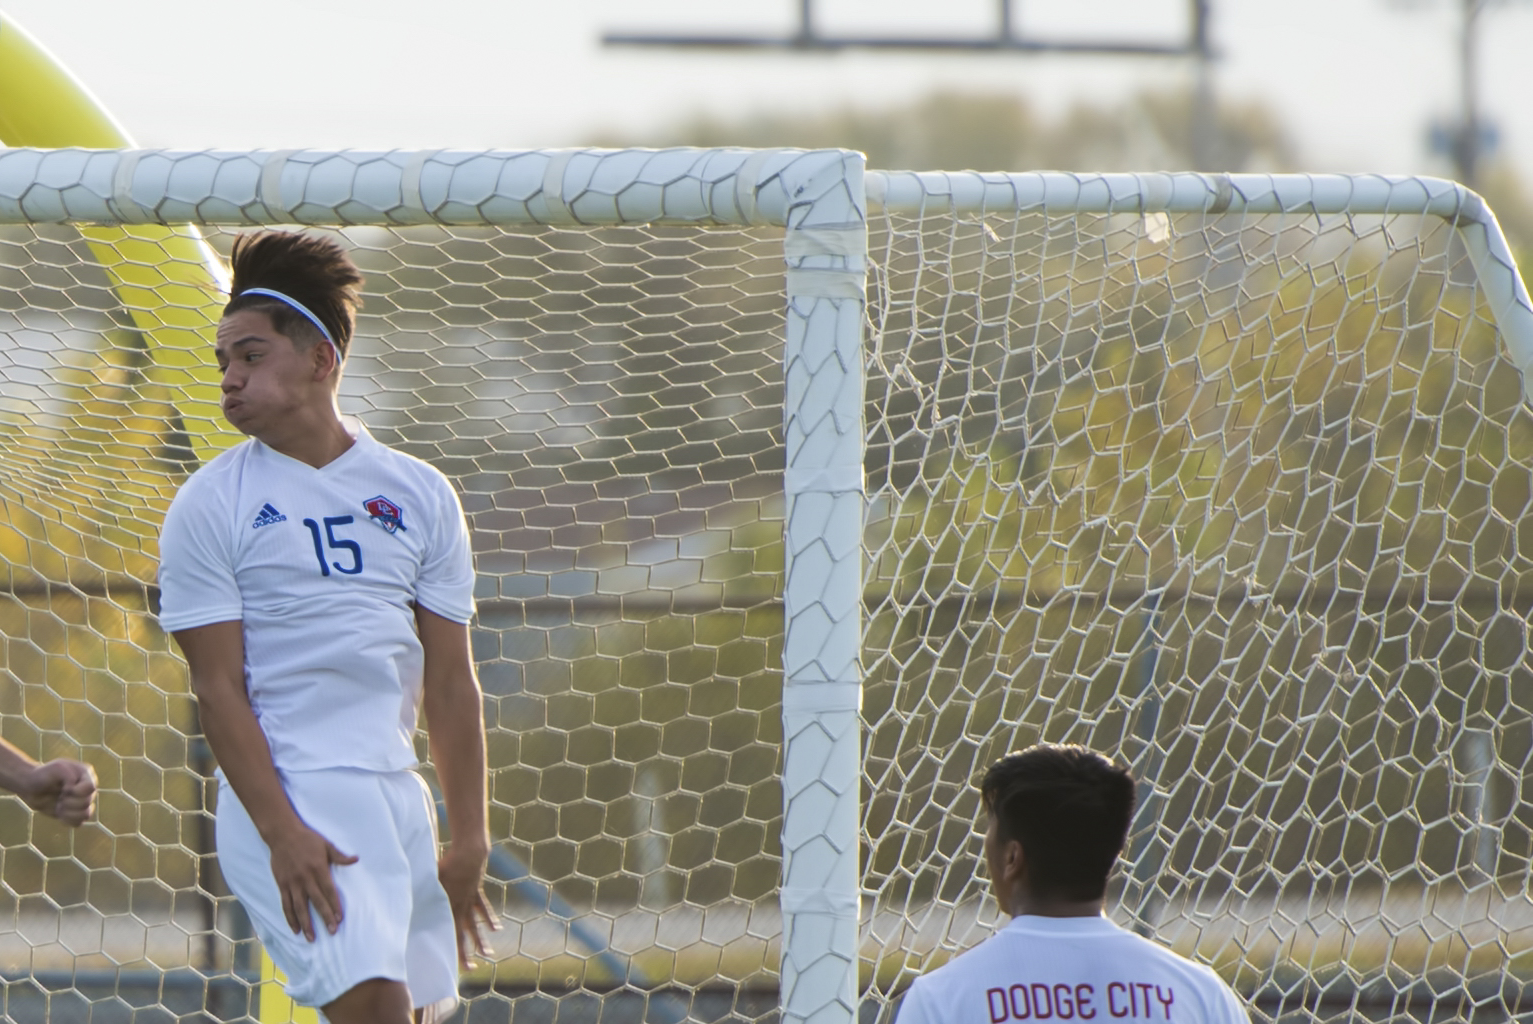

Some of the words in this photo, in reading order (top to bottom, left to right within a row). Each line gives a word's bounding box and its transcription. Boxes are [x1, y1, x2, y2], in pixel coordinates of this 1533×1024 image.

[303, 515, 363, 577] 15
[986, 983, 1097, 1024] DODGE
[1107, 981, 1174, 1020] CITY
